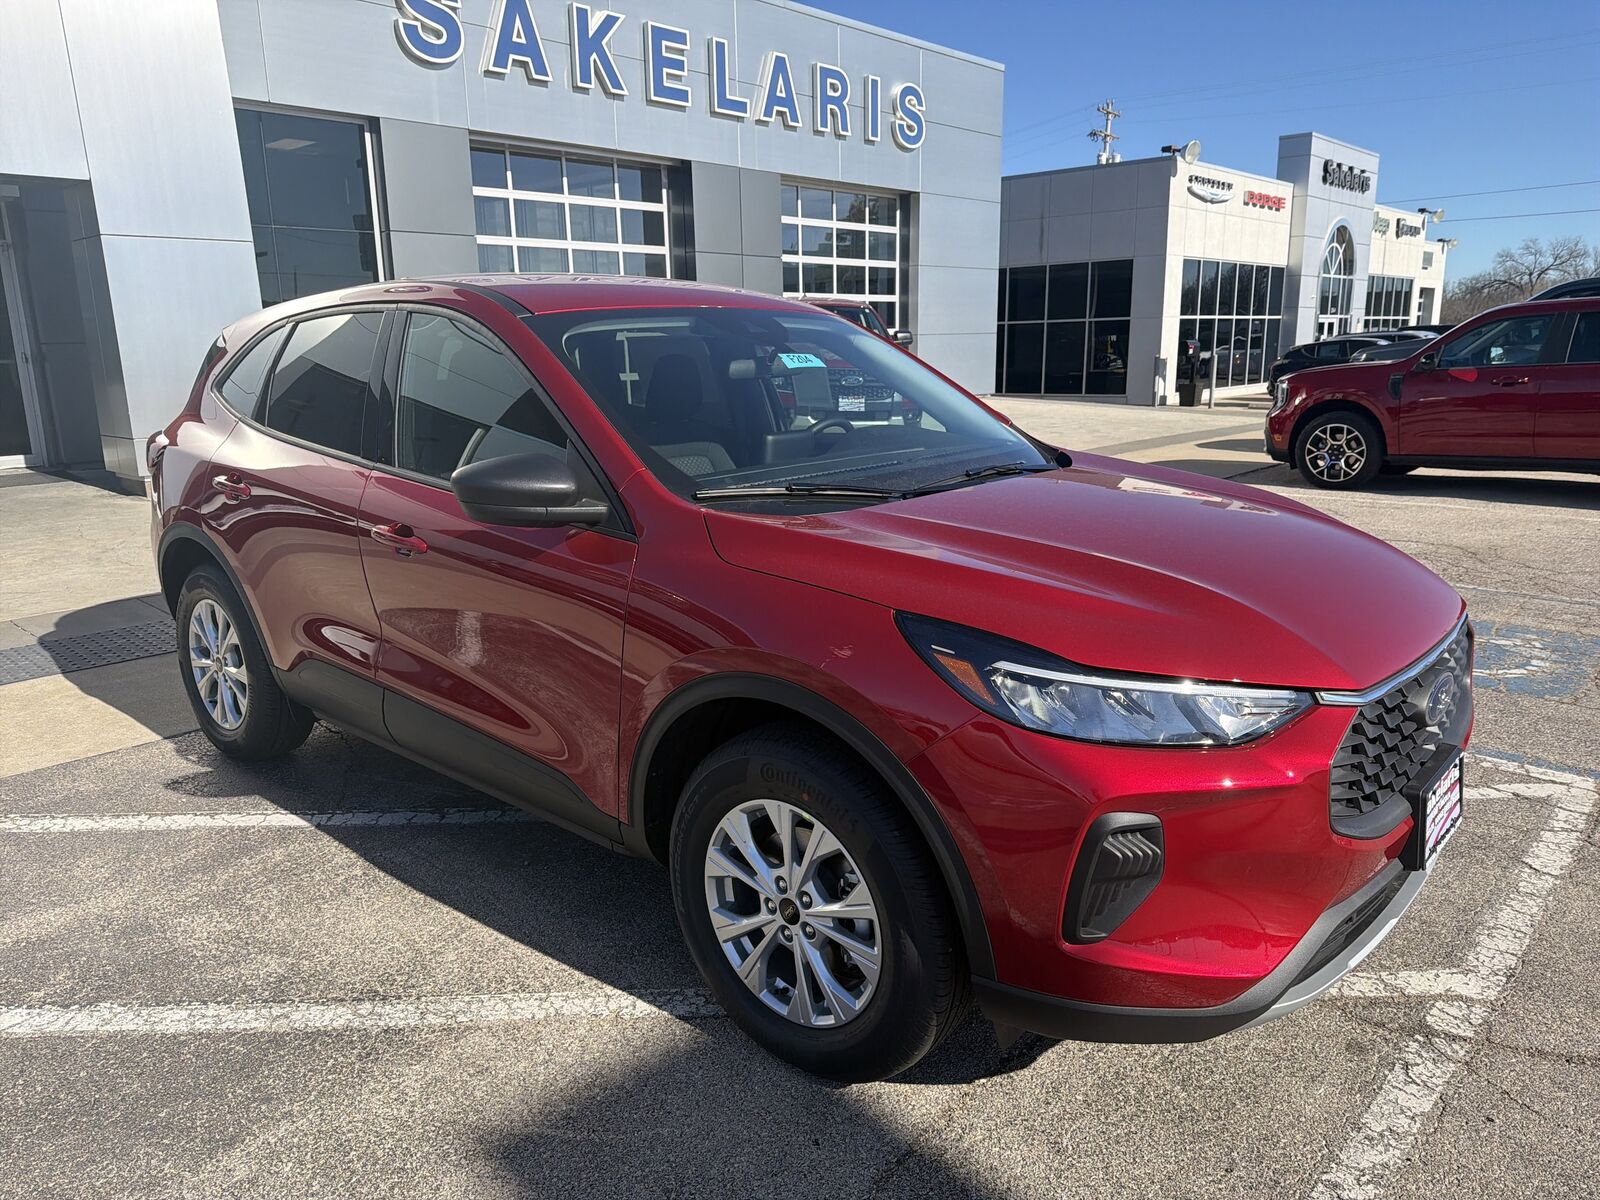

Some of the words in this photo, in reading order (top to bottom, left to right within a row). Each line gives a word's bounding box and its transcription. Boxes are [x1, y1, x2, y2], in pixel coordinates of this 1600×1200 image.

[394, 0, 927, 149] SAKELARIS
[1323, 159, 1371, 194] Sakelaris
[1245, 190, 1286, 211] DODGE
[1426, 768, 1460, 817] akelaris
